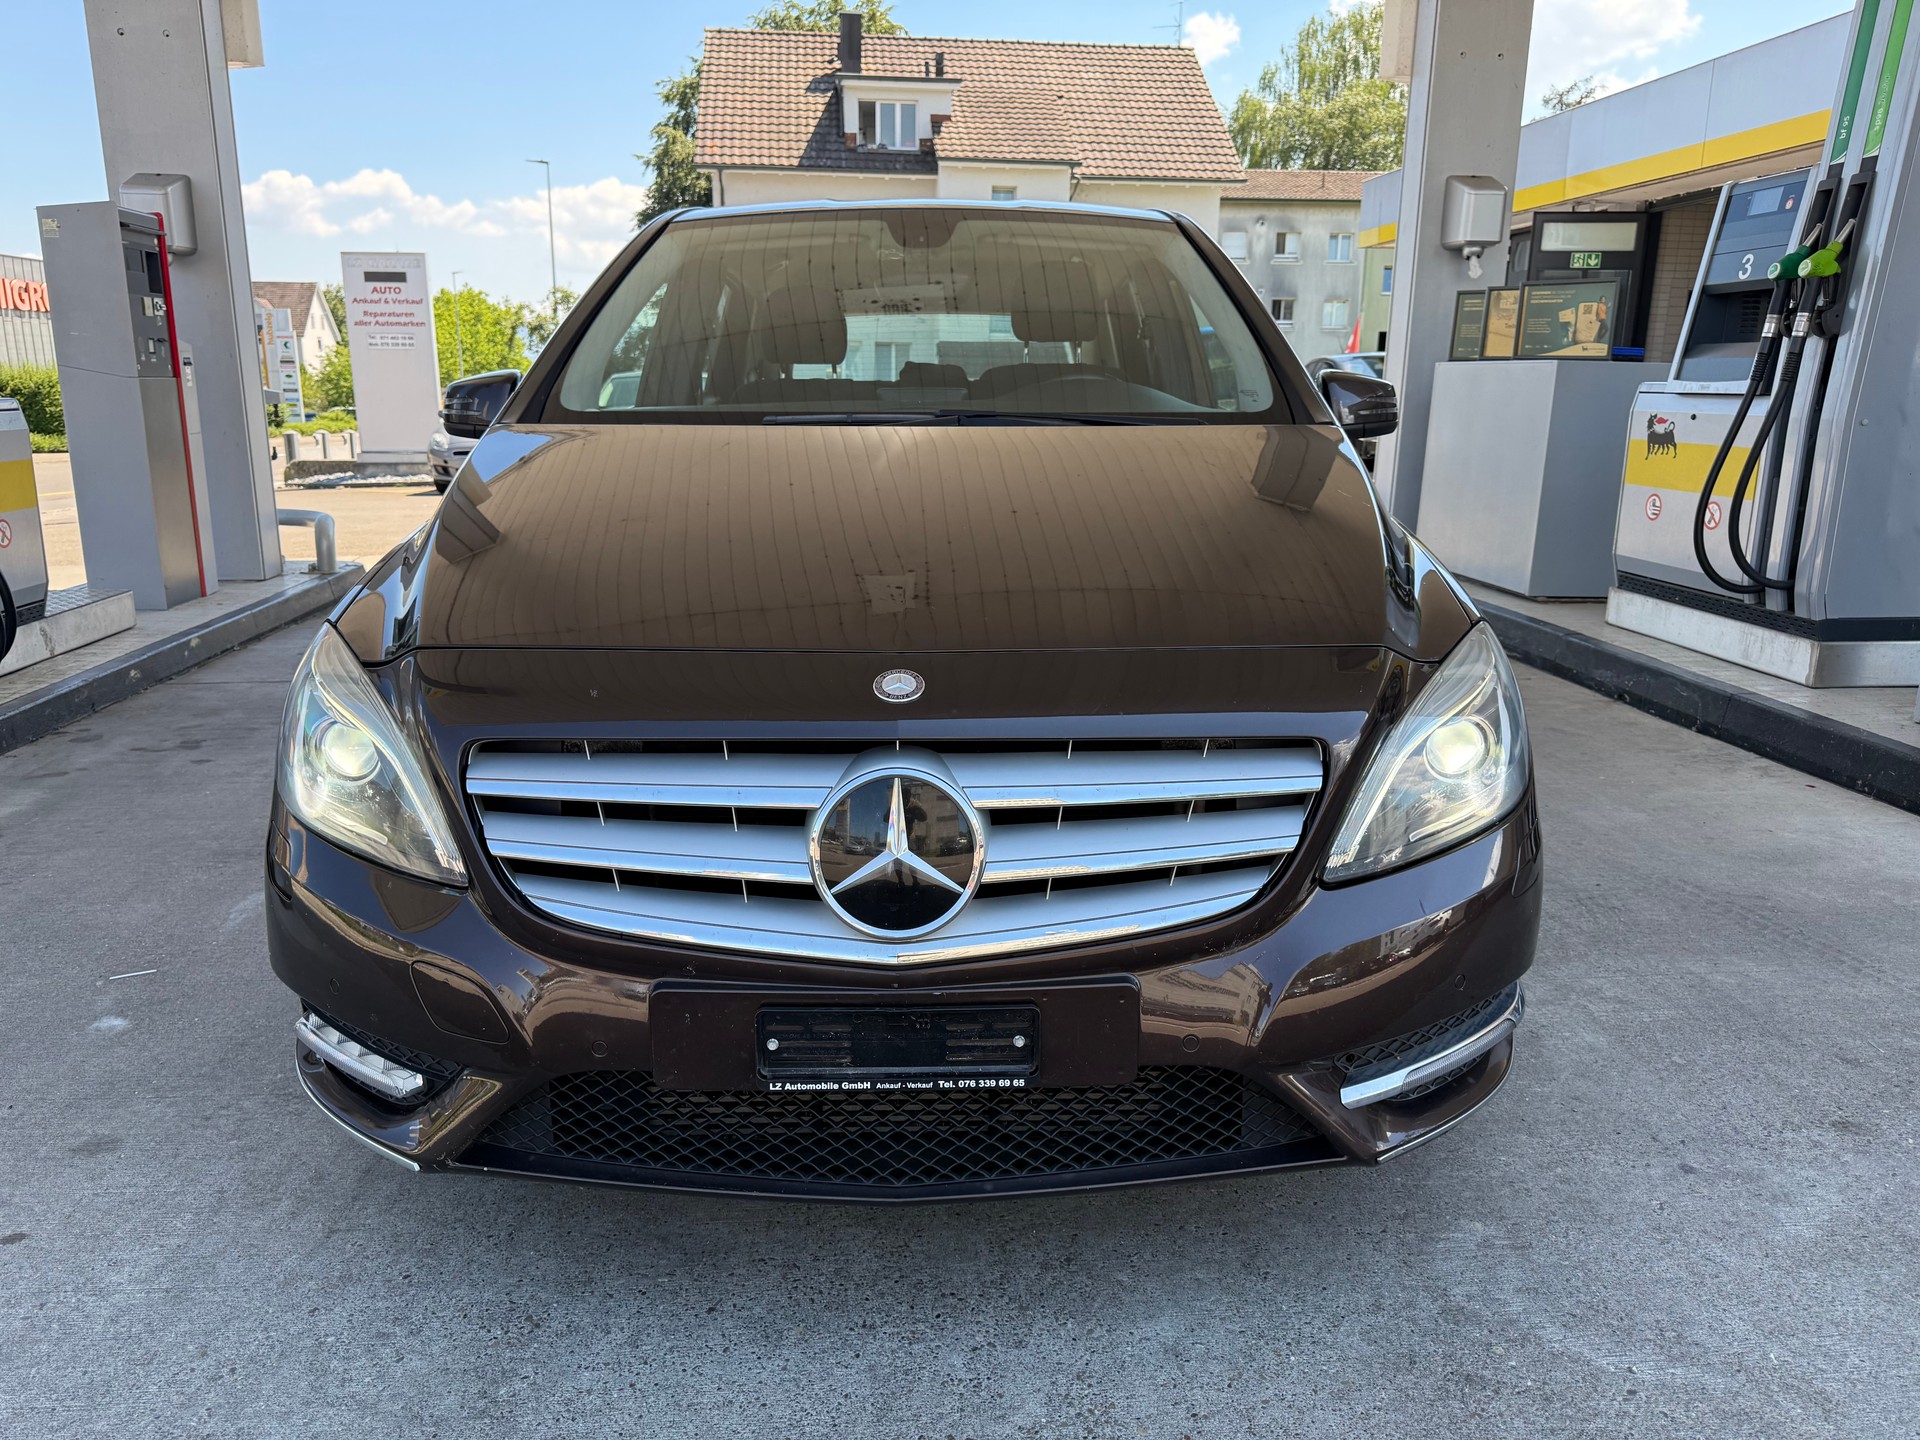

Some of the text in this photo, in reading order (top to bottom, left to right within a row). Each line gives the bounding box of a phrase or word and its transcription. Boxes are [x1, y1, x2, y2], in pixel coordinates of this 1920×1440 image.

[1738, 253, 1754, 280] 3
[371, 286, 402, 295] AUTO
[352, 297, 381, 305] Ankauf
[363, 310, 415, 319] Reparaturen
[374, 320, 426, 328] Automarken
[769, 1082, 782, 1091] LZ
[784, 1082, 840, 1091] Automobile
[841, 1081, 871, 1090] GmbH
[906, 1081, 933, 1089] Verkauf
[938, 1080, 956, 1088] Tel.
[958, 1079, 976, 1088] 076
[978, 1079, 996, 1088] 339
[998, 1079, 1011, 1087] 69
[1012, 1079, 1025, 1087] 65
